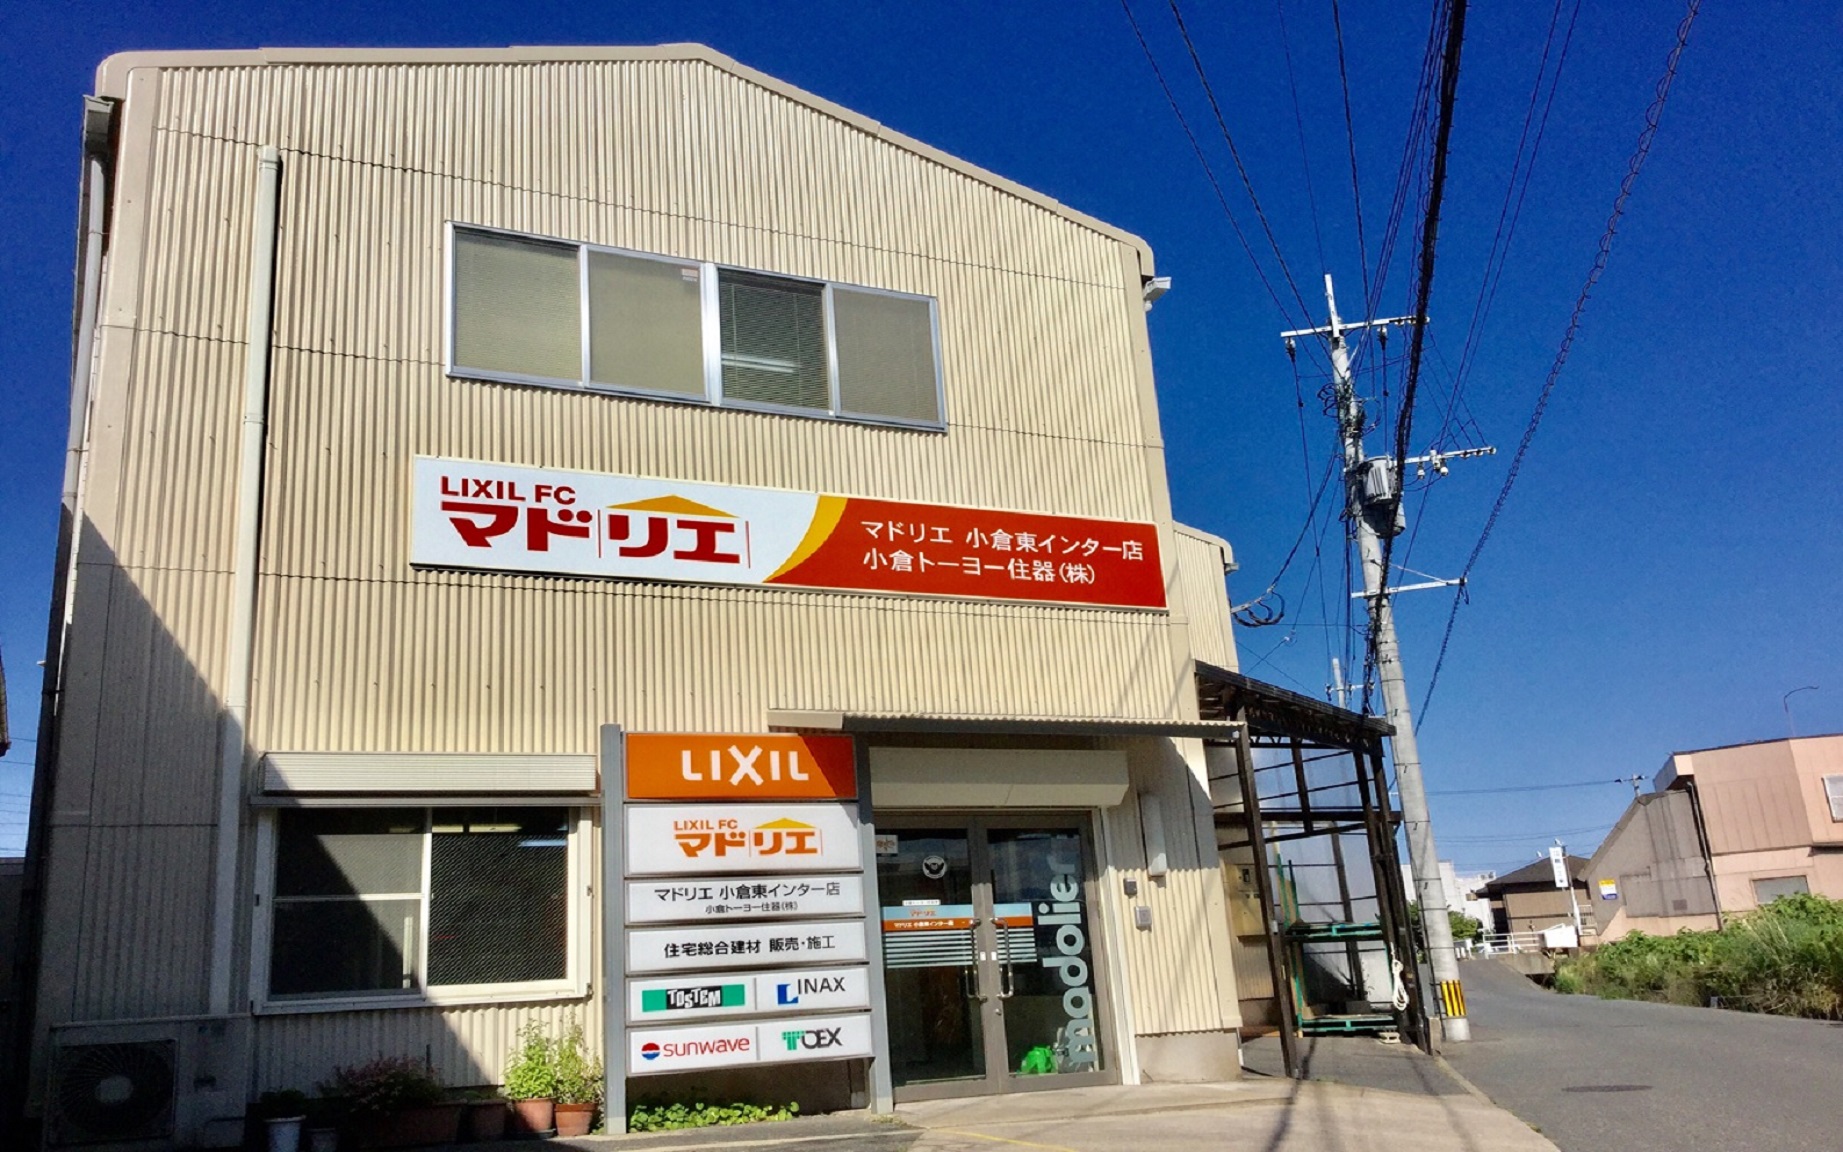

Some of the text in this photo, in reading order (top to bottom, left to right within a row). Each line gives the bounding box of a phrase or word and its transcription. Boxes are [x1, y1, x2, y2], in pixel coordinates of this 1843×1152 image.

[441, 476, 576, 505] LIXIL FC
[441, 501, 740, 564] マドリエ
[861, 520, 1144, 561] マドリエ 小倉東インター店
[863, 548, 1096, 585] 小倉トーヨー住器(株)
[681, 745, 809, 786] LIXIL
[673, 819, 738, 830] LIXIL FC
[674, 831, 818, 857] マドリエ
[654, 882, 841, 902] マドリエ 小倉東インター店
[664, 940, 762, 959] 住宅総合建材
[1037, 853, 1097, 1063] madolier
[667, 976, 846, 1009] TOSTEM INAX
[663, 1026, 843, 1057] sunwave TOEX
